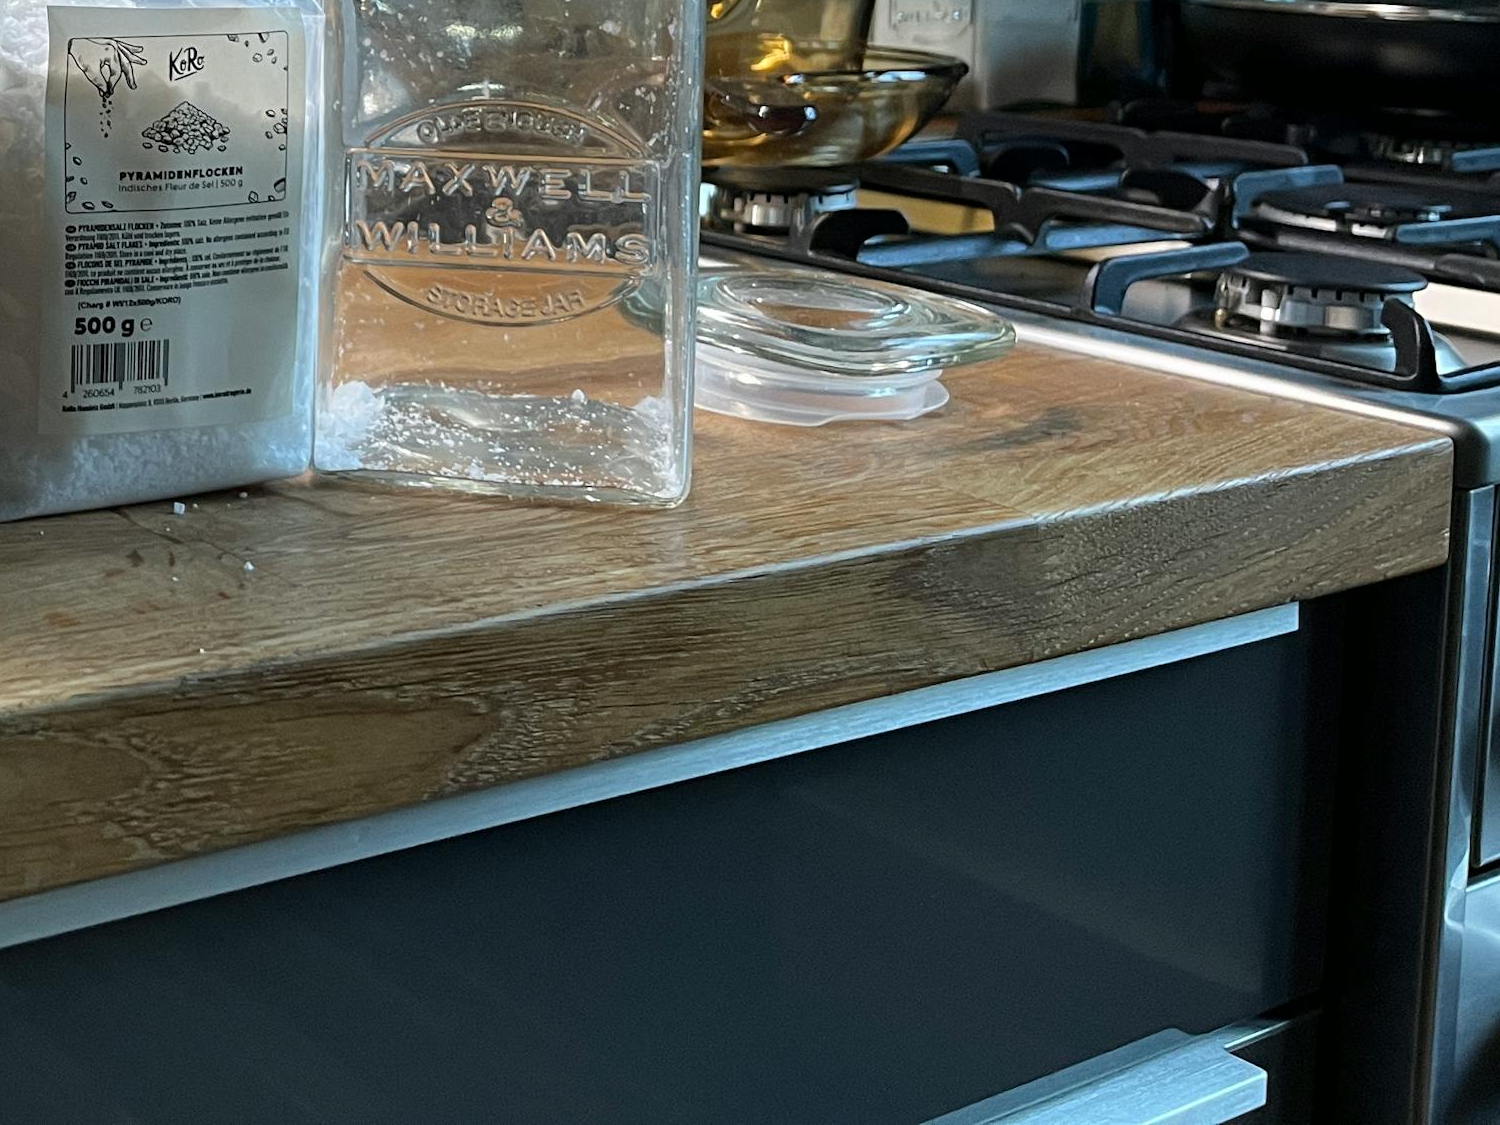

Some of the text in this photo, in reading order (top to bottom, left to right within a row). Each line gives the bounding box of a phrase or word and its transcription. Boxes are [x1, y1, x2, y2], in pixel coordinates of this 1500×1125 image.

[169, 47, 205, 81] KoRo
[118, 182, 163, 192] Indisches
[165, 181, 186, 191] Fleur
[189, 181, 200, 190] de
[202, 180, 214, 189] Sel
[220, 179, 236, 188] 500
[237, 180, 243, 189] g
[119, 166, 243, 181] PYRAMIDENFLOCKEN
[356, 161, 652, 204] MAXWELL
[485, 196, 524, 229] &
[354, 219, 652, 266] WILLIAMS
[78, 300, 104, 311] (Charg
[426, 284, 537, 318] STORAGE
[74, 316, 116, 335] 500
[121, 318, 134, 337] g
